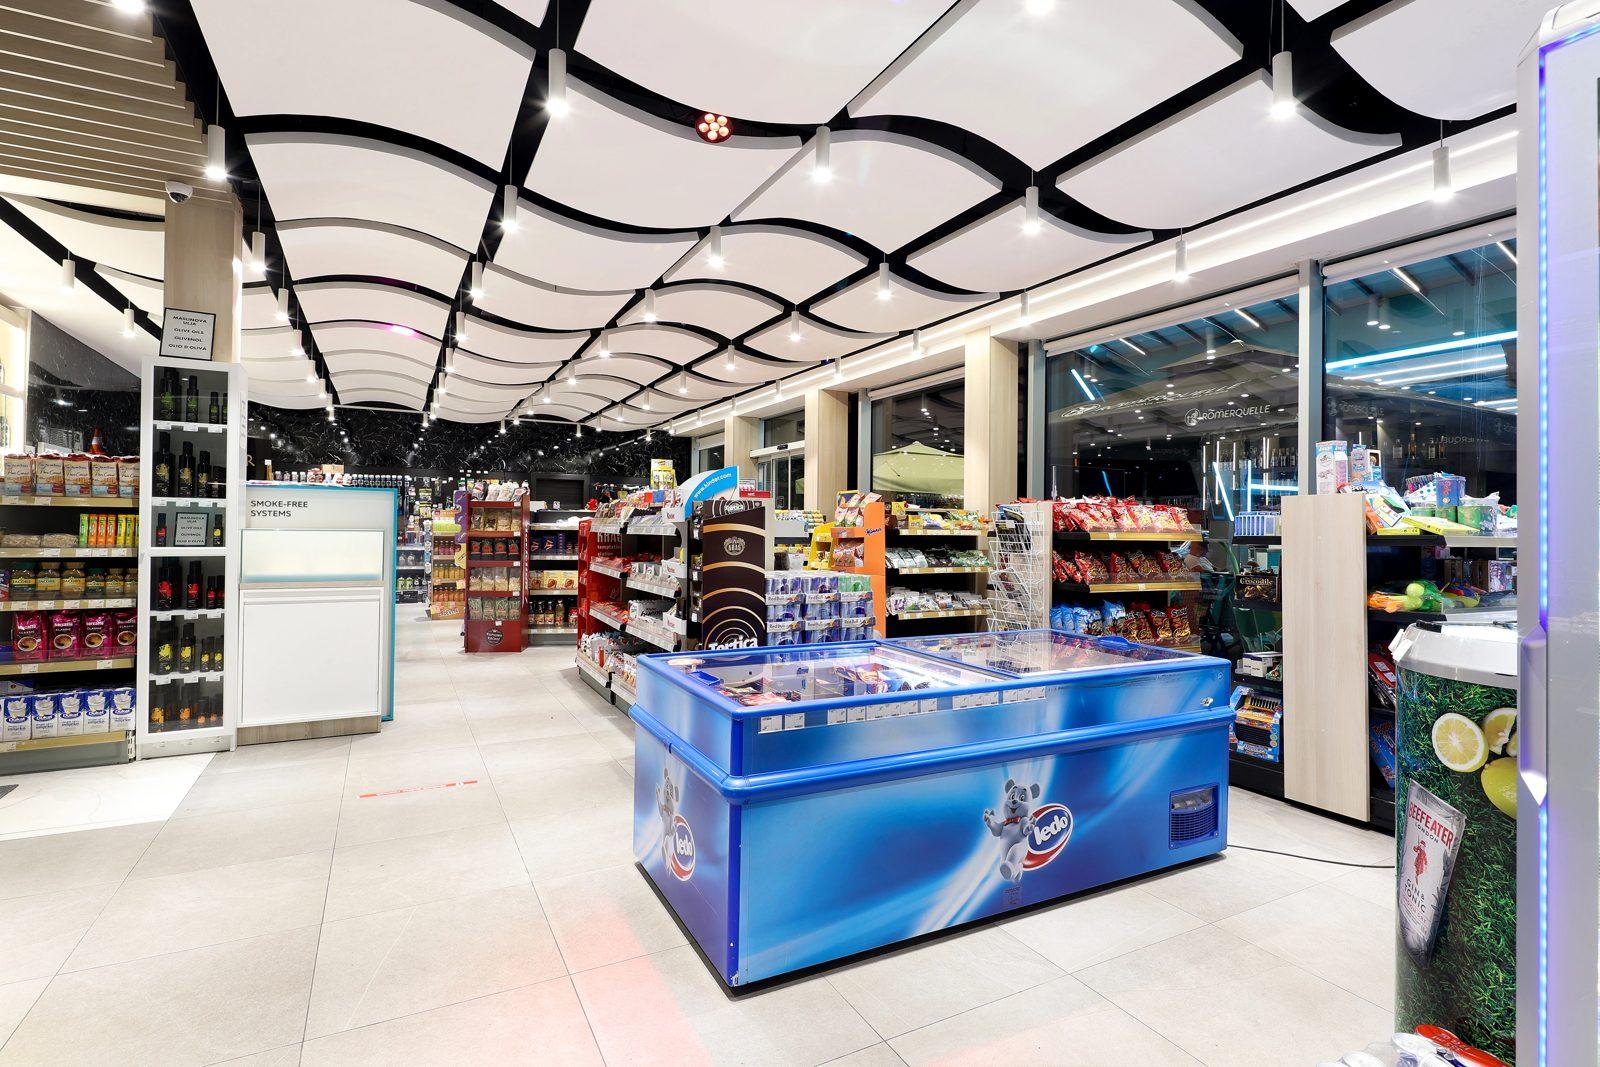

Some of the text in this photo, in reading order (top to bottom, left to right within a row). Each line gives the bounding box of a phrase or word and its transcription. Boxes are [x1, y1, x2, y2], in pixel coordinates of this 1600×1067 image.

[173, 315, 207, 323] MASLINOVA
[250, 500, 308, 508] SMOKE-FREE
[1240, 577, 1273, 586] Crocodile
[1033, 815, 1068, 845] ledo
[1408, 800, 1454, 850] BEEFEATER
[1414, 823, 1439, 844] LONDON
[675, 832, 693, 857] ledo
[1404, 884, 1426, 913] TONIC
[1406, 878, 1420, 898] GIN
